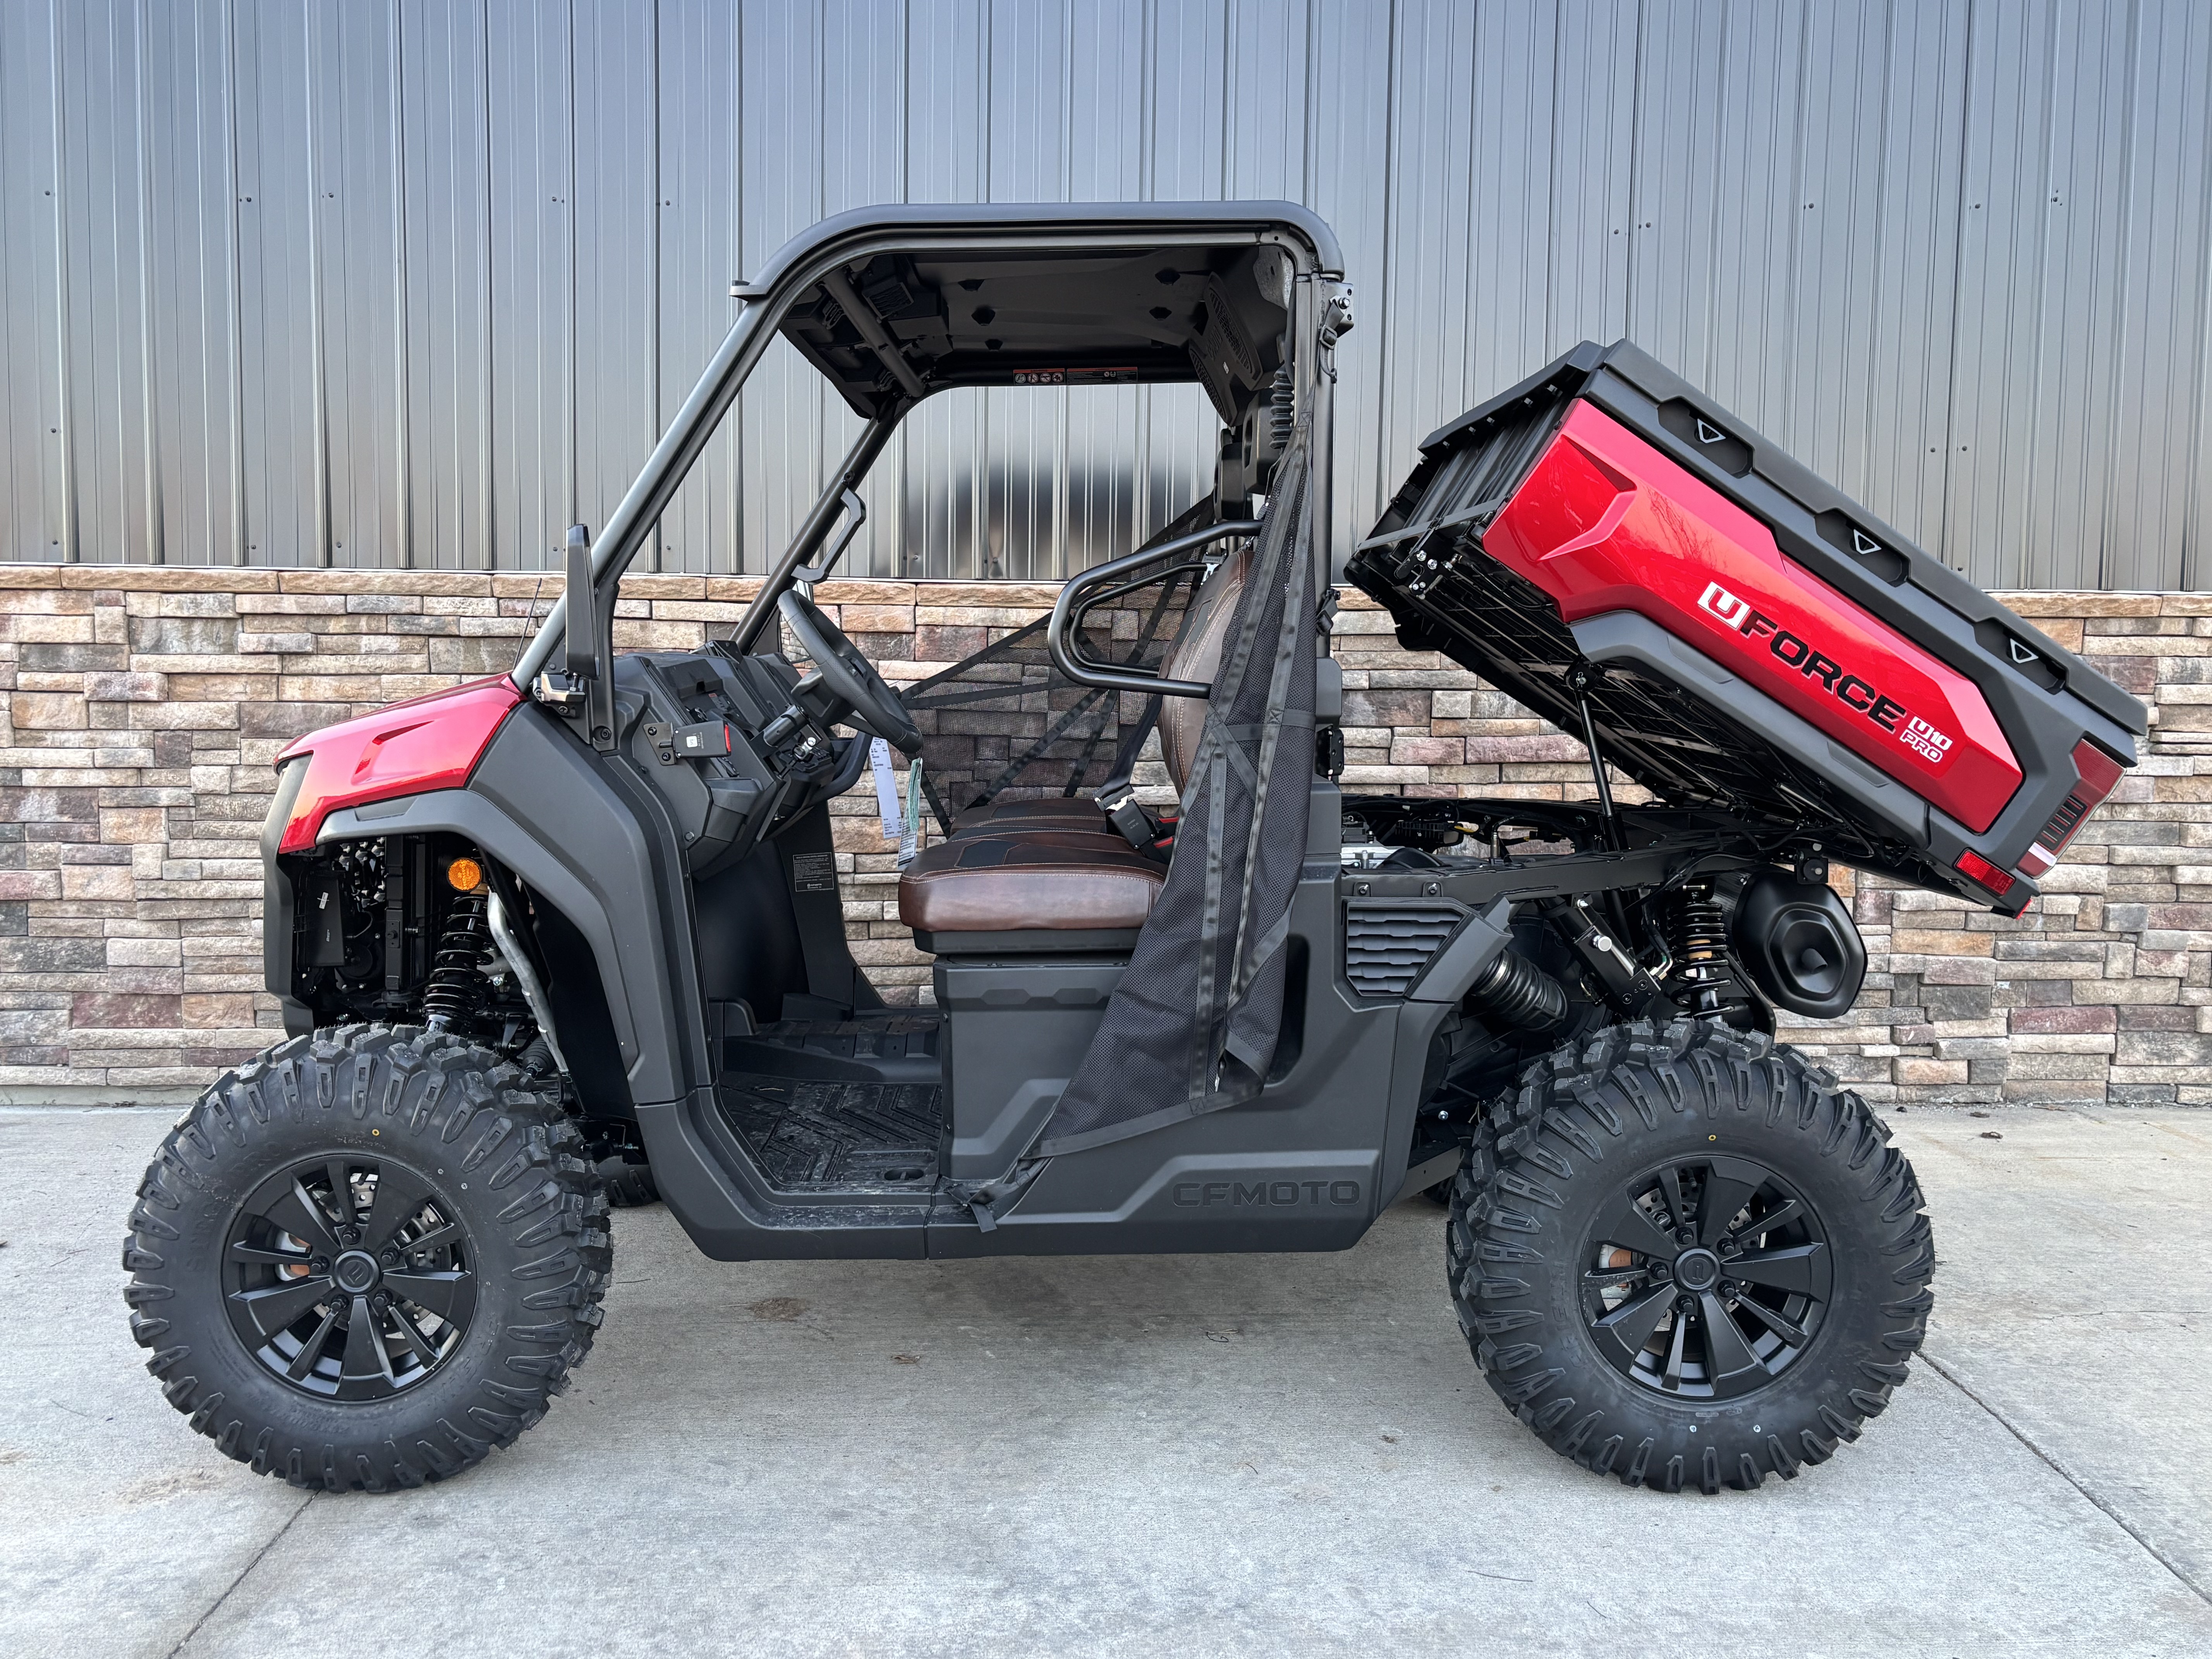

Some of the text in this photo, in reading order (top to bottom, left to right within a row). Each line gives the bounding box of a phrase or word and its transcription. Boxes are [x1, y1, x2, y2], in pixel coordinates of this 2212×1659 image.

[1899, 730, 1943, 763] PRO
[1908, 716, 1953, 751] U10
[1172, 1181, 1360, 1208] CFMOTO
